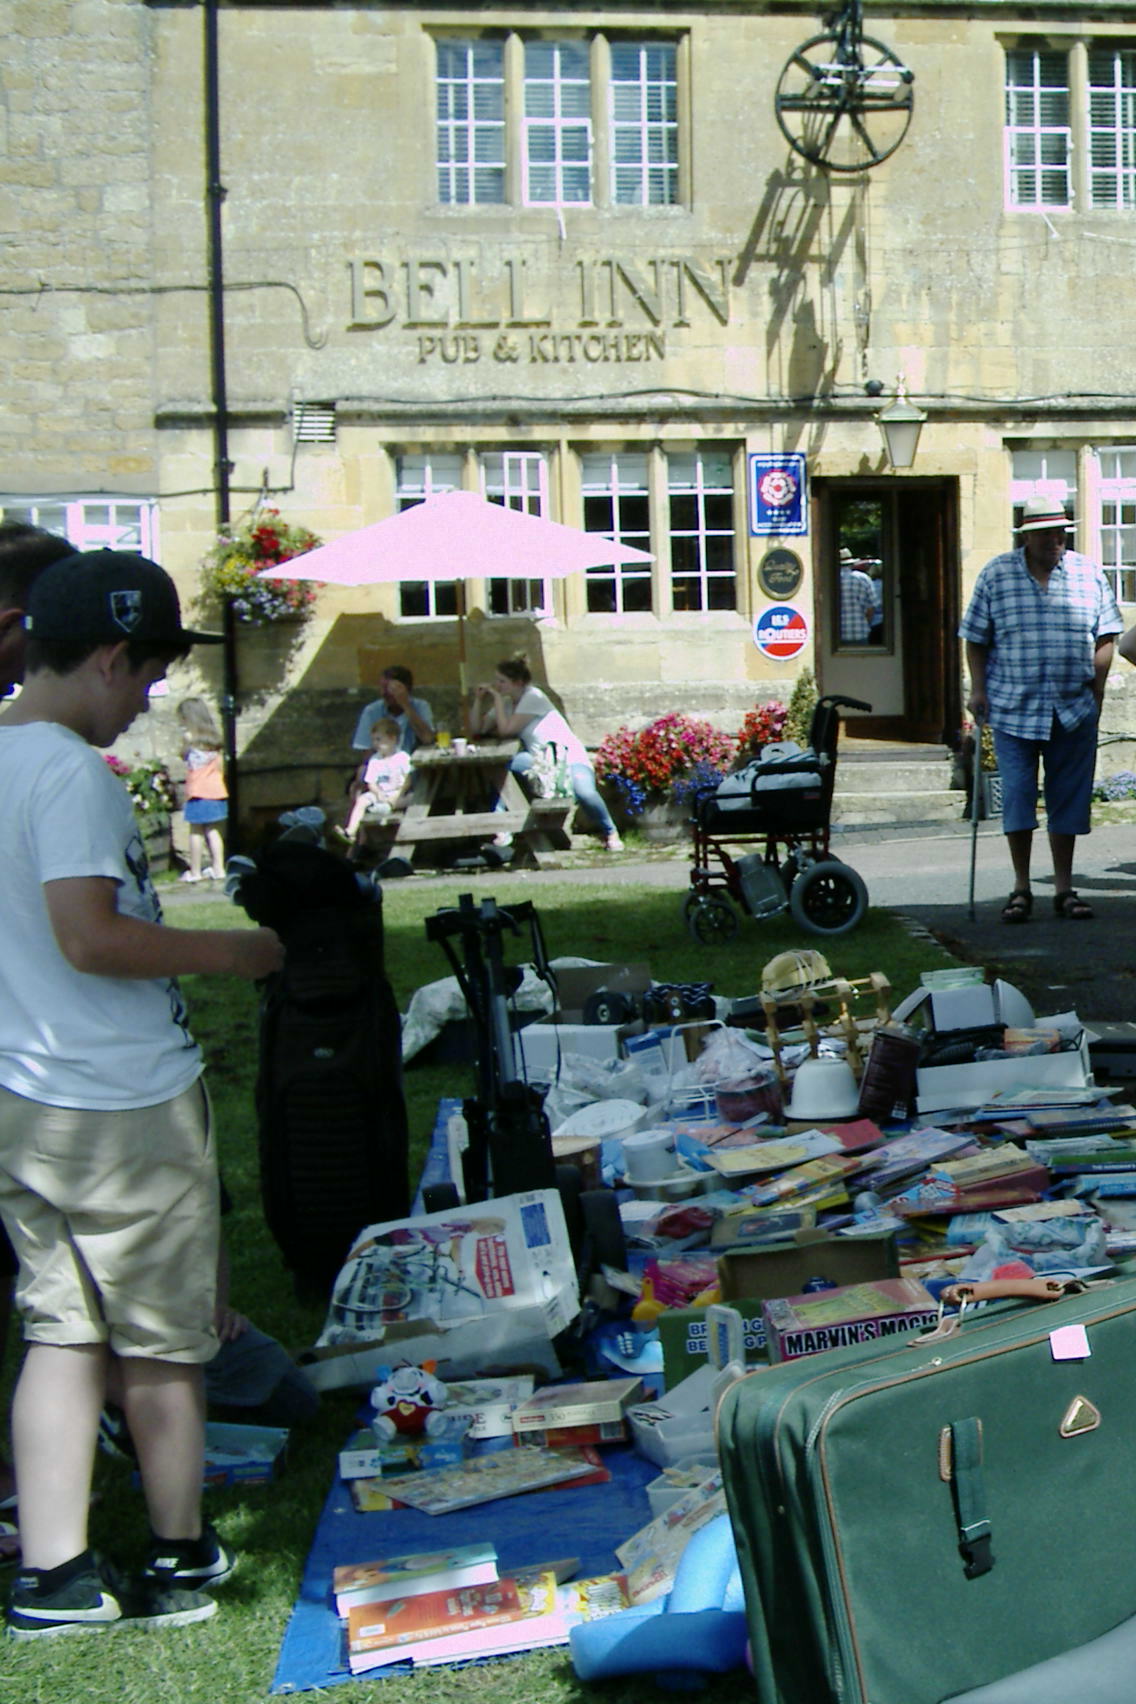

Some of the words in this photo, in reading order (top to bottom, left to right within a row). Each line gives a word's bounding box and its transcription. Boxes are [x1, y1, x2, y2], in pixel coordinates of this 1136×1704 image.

[346, 260, 552, 331] BELL
[575, 259, 733, 328] INN
[416, 335, 481, 364] PUB
[492, 335, 521, 363] &
[529, 331, 667, 363] KITCHEN
[771, 614, 790, 627] LES
[785, 1321, 877, 1356] MARVIN'S
